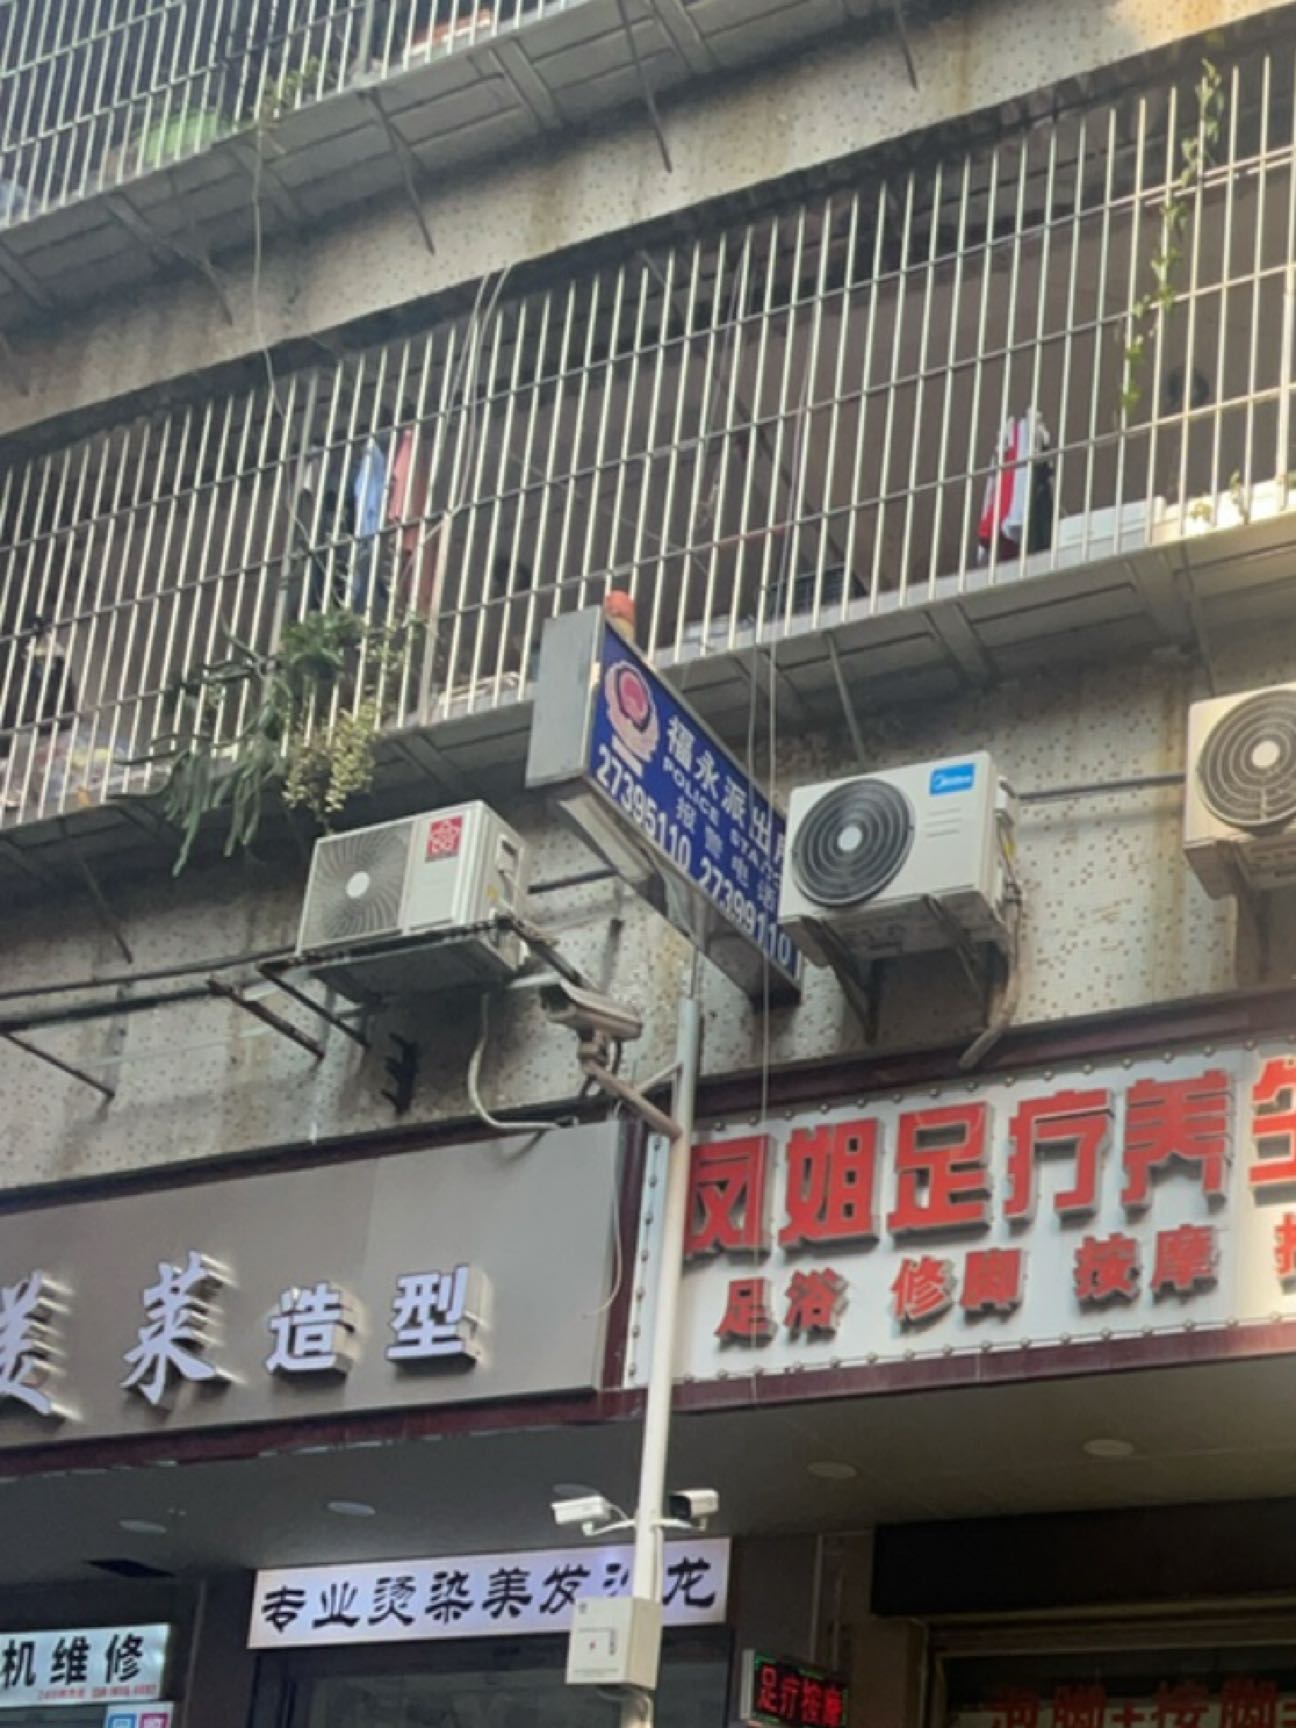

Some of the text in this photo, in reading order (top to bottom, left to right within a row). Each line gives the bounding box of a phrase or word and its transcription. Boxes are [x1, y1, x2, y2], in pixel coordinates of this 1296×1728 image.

[596, 742, 792, 966] 27395110 27399110
[714, 1266, 848, 1336] 足浴
[890, 1246, 1022, 1322] 修脚
[1074, 1222, 1217, 1298] 按摩
[262, 1556, 716, 1632] 专业烫染美发龙
